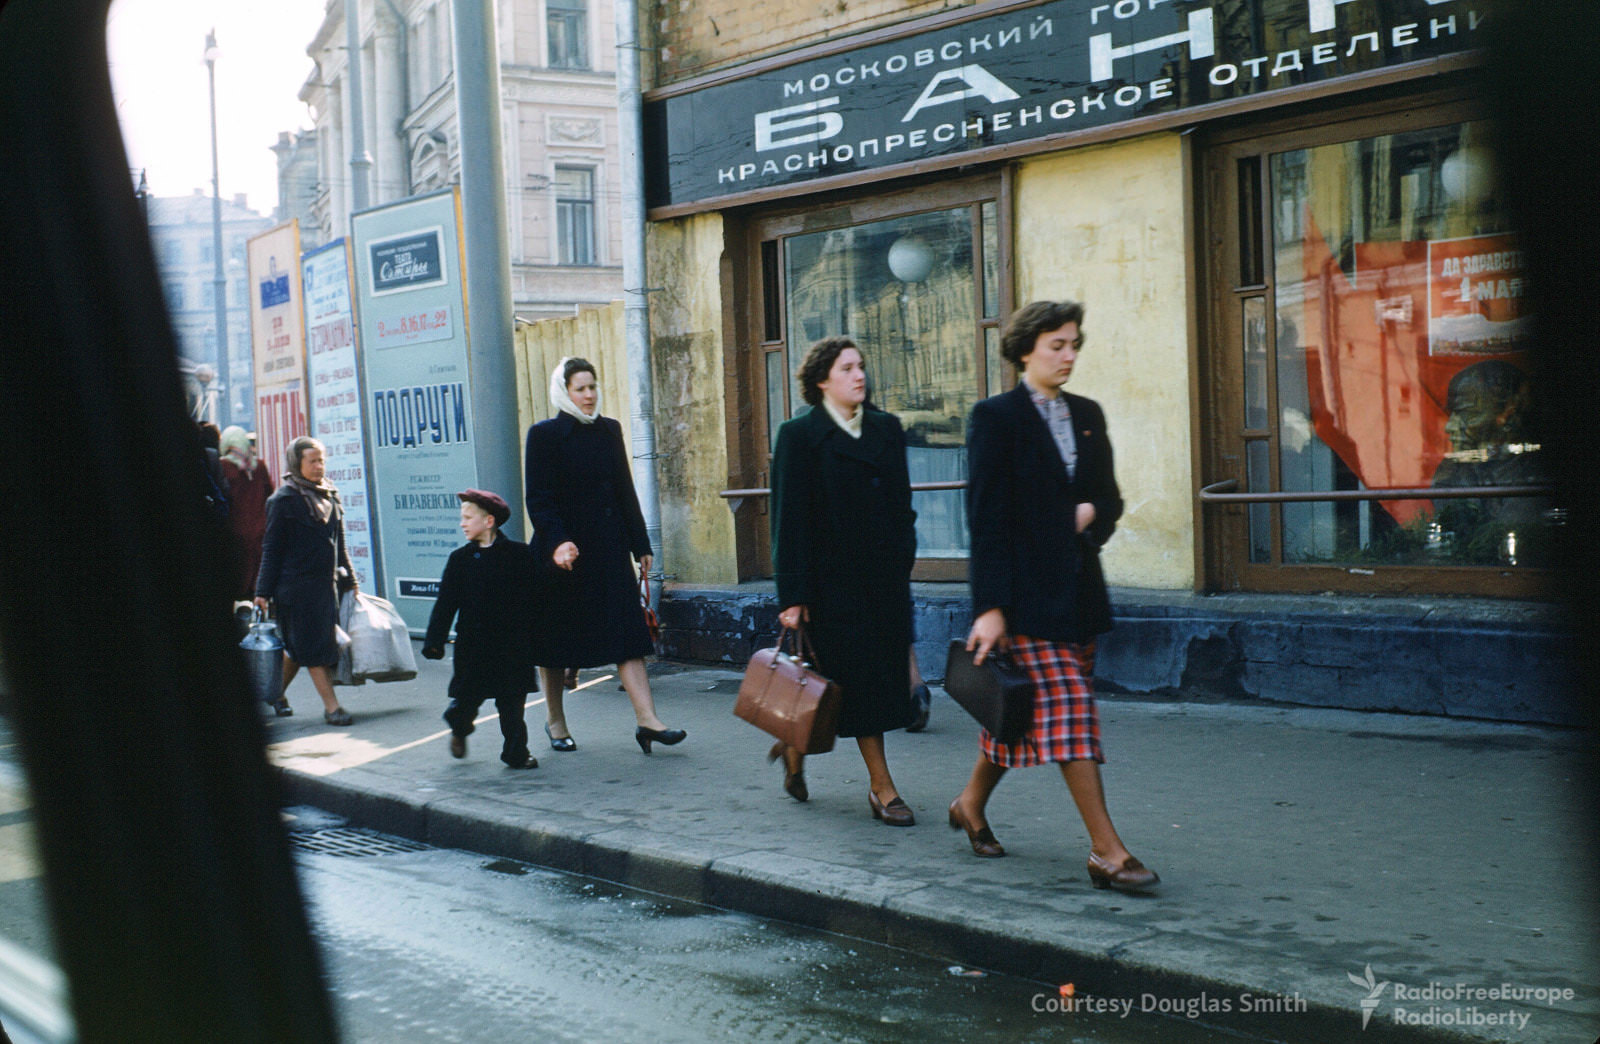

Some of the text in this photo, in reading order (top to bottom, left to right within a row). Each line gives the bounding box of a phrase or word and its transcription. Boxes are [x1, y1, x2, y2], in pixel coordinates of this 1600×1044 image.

[784, 15, 1053, 98] МОСКОВСКИЙ
[718, 78, 1174, 184] КРАСНОПРЕСНЕНСКОЕ
[1441, 257, 1460, 277] ДА
[374, 383, 467, 448] ПОДРУГИ
